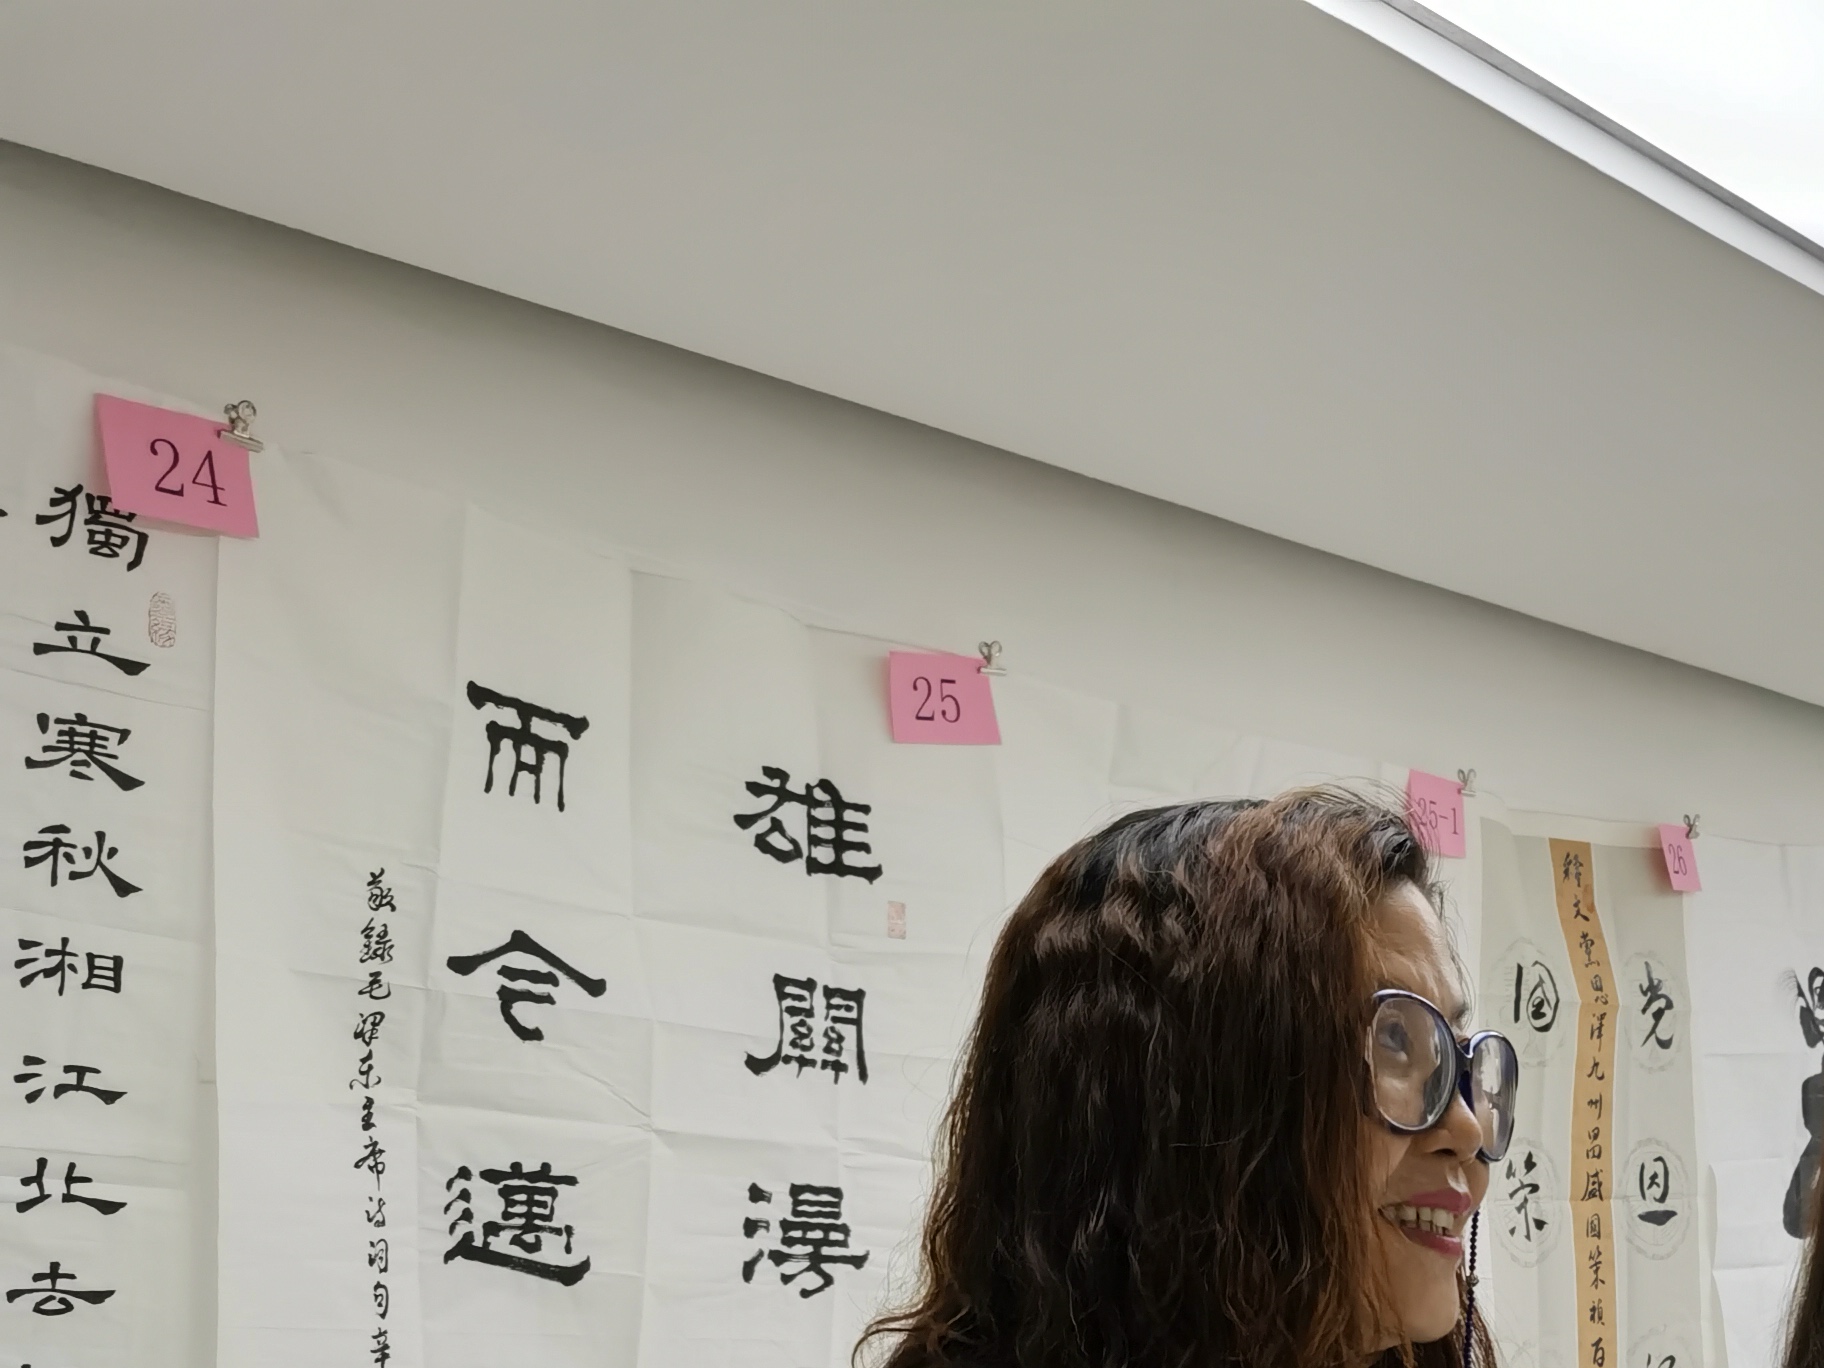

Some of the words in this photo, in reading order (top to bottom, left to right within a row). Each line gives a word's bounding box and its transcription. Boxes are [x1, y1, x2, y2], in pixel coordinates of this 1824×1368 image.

[148, 436, 231, 508] 24
[911, 675, 963, 725] 25
[1417, 796, 1460, 836] 25-1
[1667, 843, 1688, 878] 26
